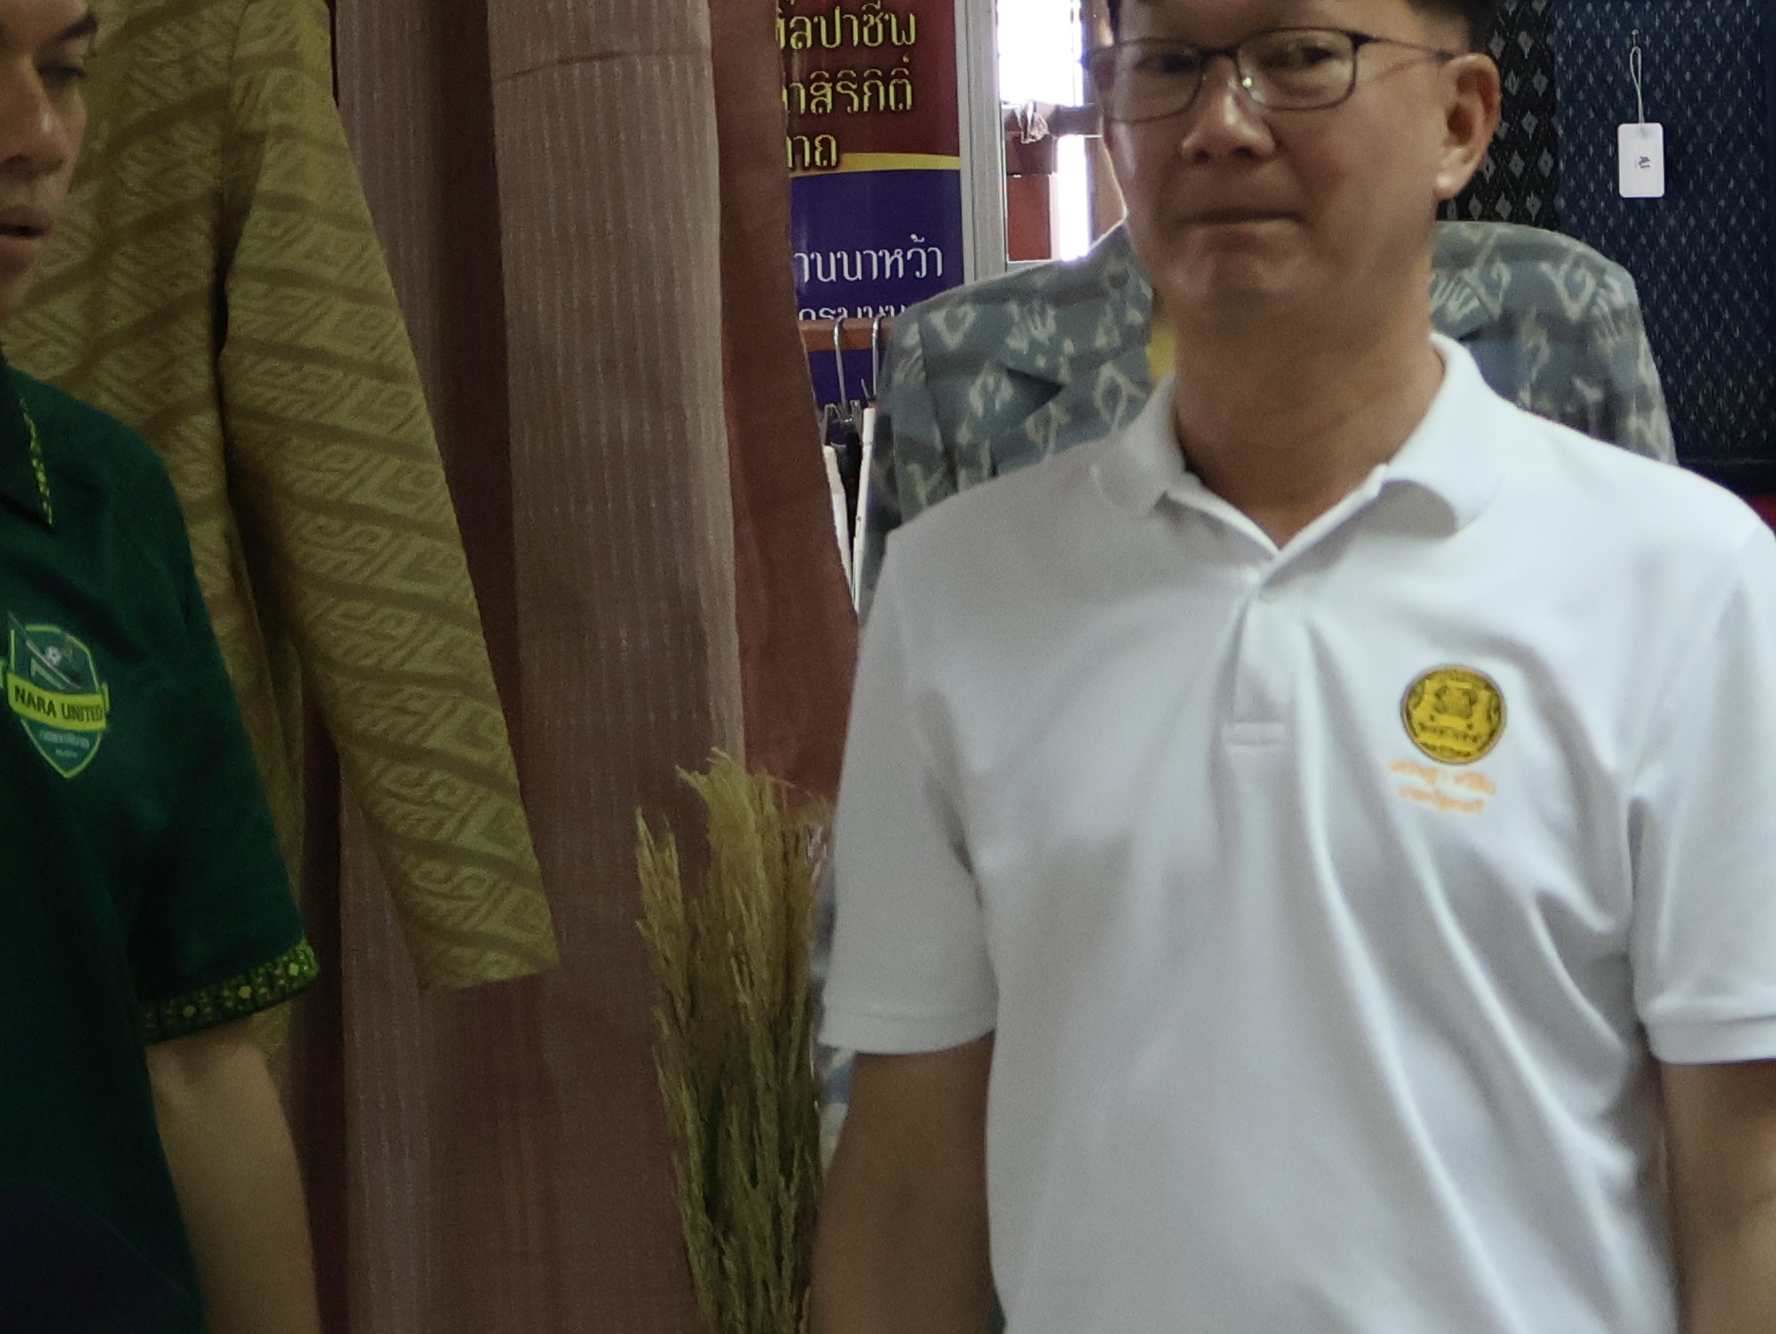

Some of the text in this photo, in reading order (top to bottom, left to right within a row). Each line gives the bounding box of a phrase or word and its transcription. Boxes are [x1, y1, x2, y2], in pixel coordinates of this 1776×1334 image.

[776, 0, 916, 49] ลปาชีพ
[782, 55, 912, 114] าสิริกิติ์
